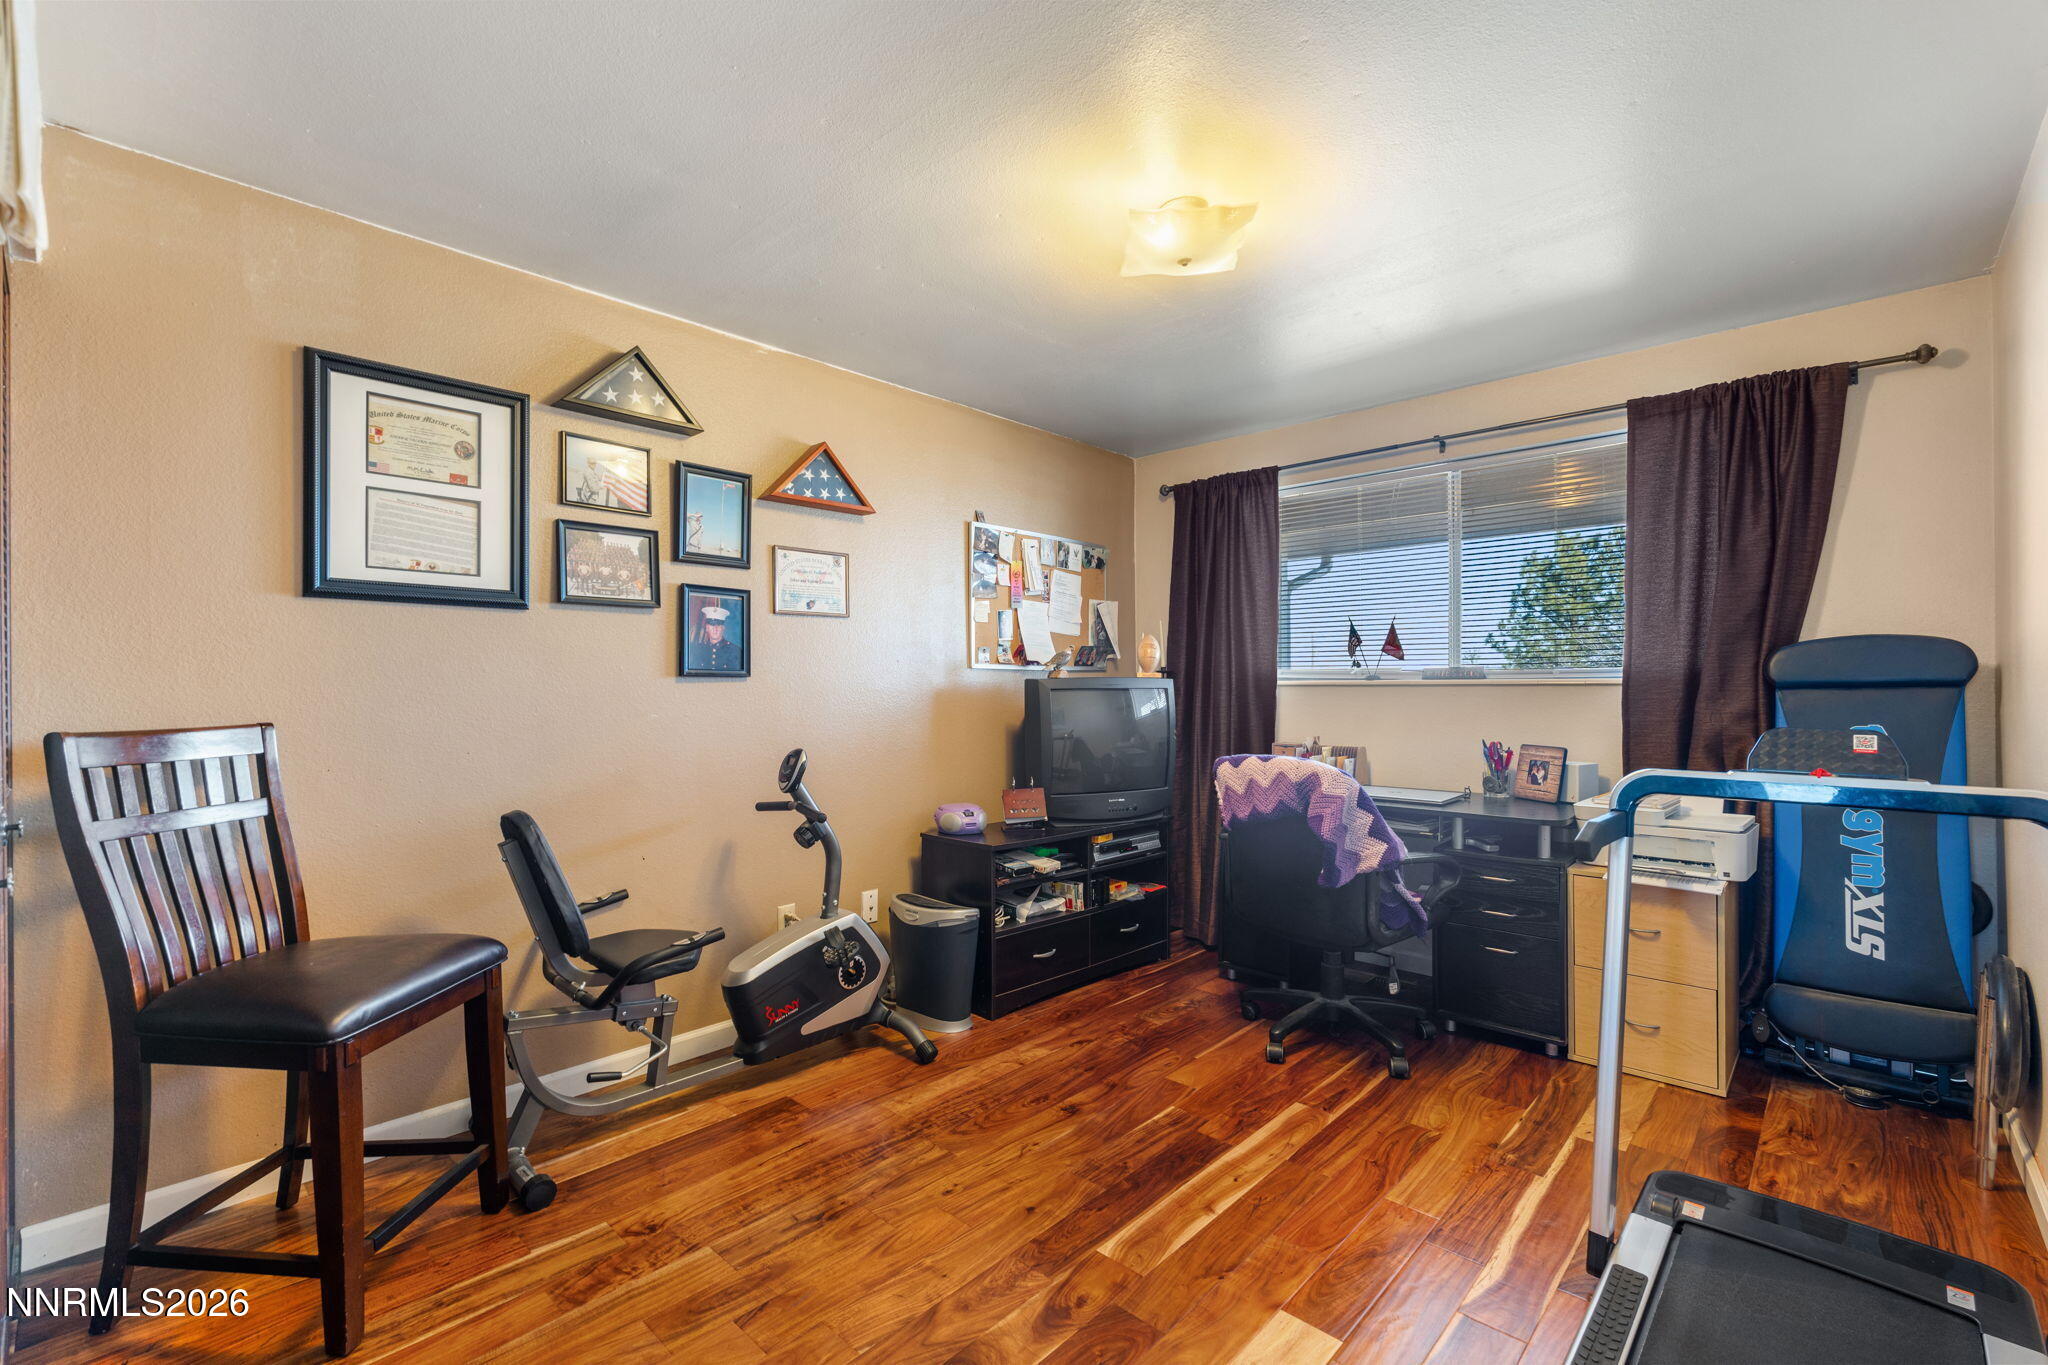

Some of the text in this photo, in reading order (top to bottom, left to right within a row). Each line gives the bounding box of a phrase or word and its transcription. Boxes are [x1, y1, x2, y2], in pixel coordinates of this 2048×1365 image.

[396, 411, 420, 421] States
[421, 416, 449, 428] Marine
[1840, 808, 1886, 961] gym XLS
